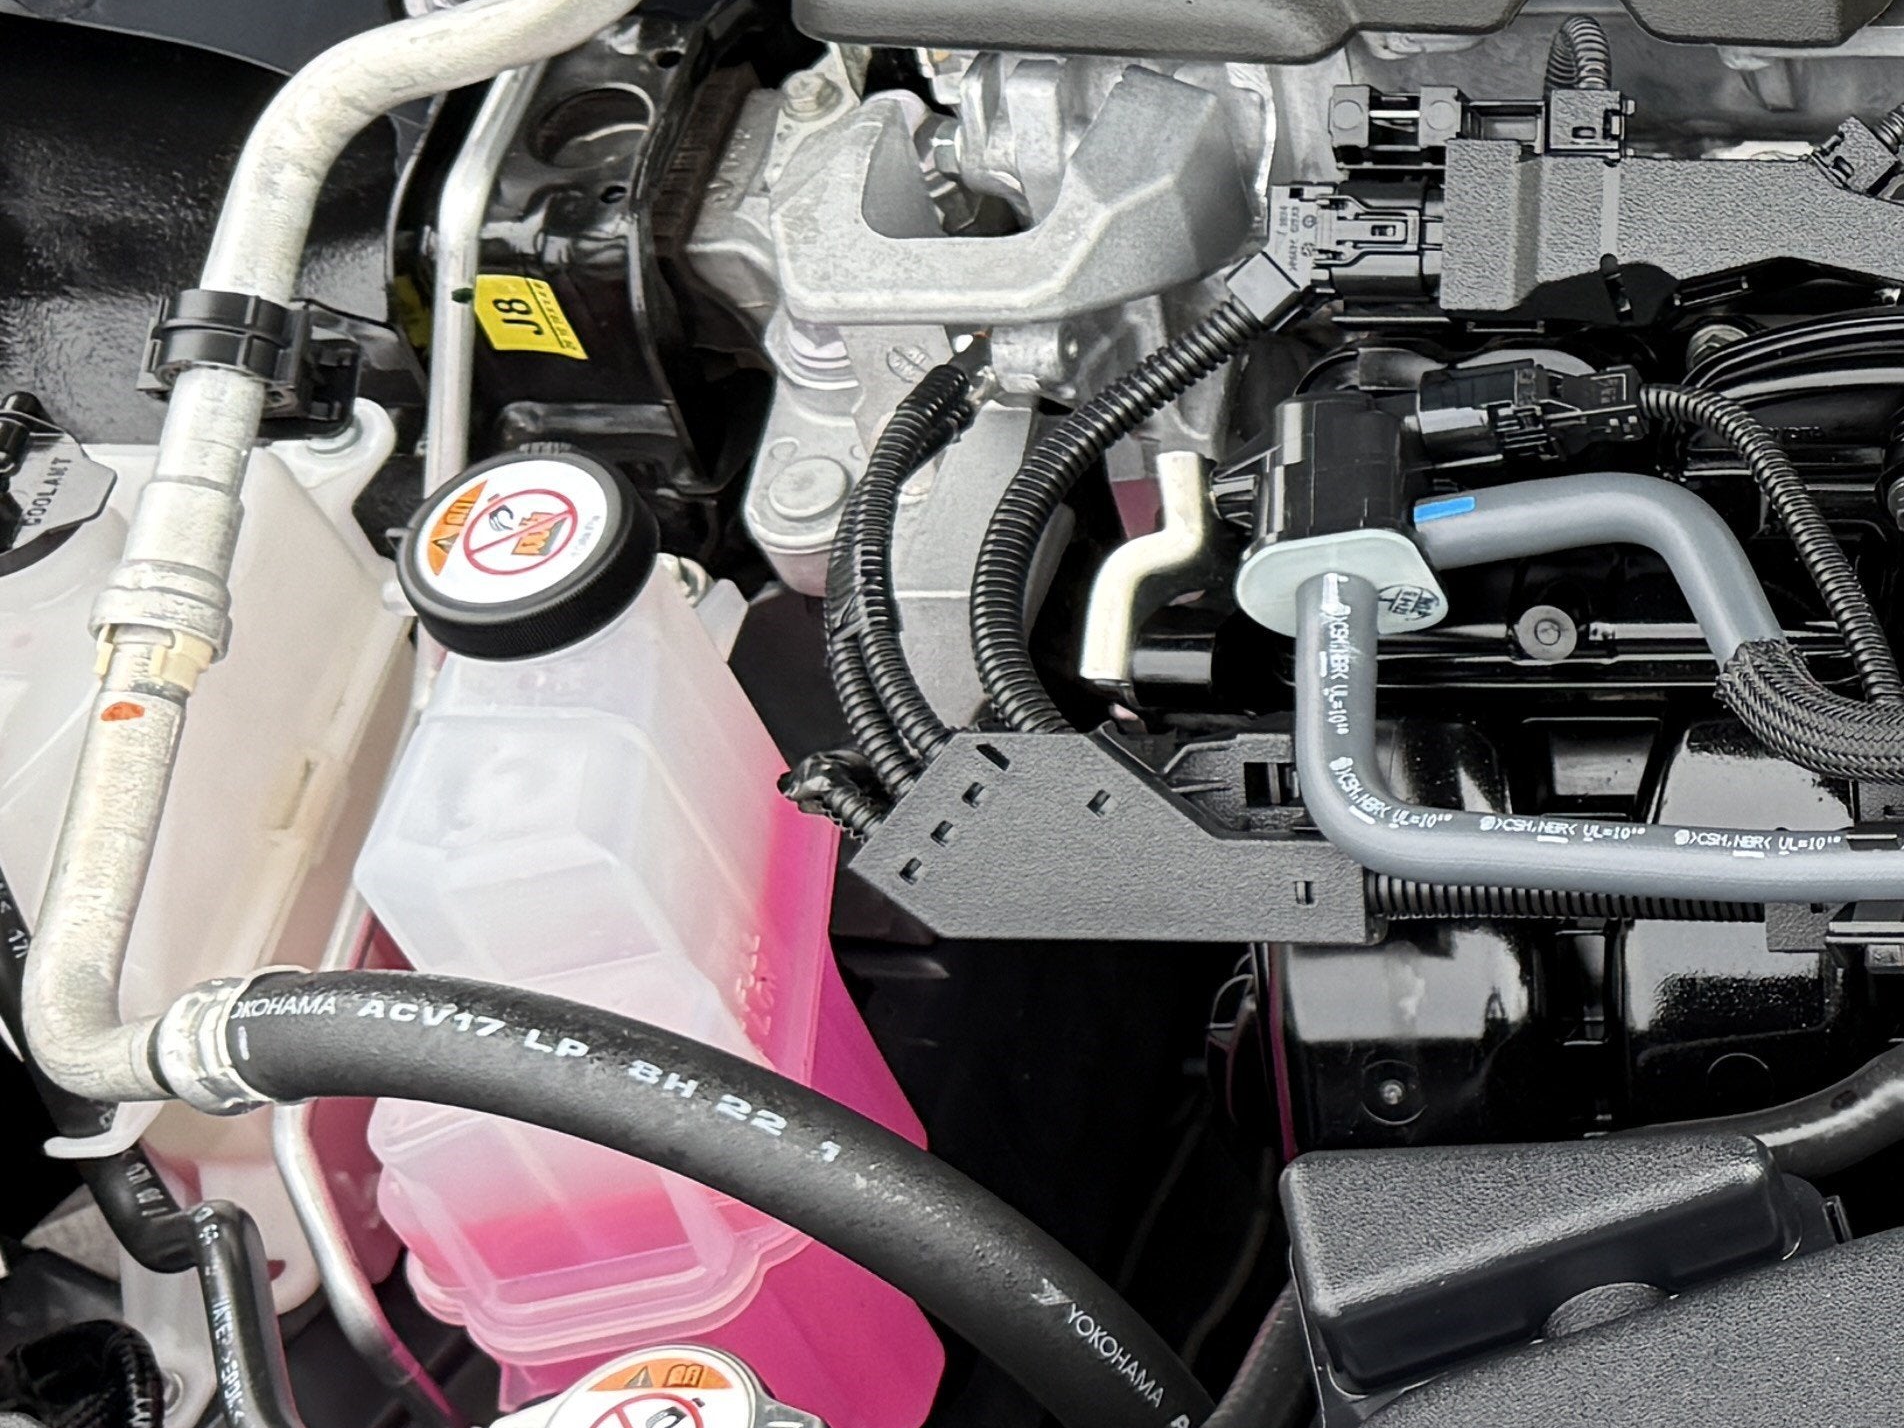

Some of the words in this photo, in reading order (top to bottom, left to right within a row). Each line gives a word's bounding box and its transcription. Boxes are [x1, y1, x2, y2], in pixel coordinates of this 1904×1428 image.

[492, 299, 544, 335] J8
[231, 996, 336, 1019] OKOHAMA
[357, 999, 506, 1037] ACV17
[523, 1028, 590, 1057] LP
[714, 1093, 788, 1137] 22
[1068, 1303, 1164, 1408] YOKOHAMA
